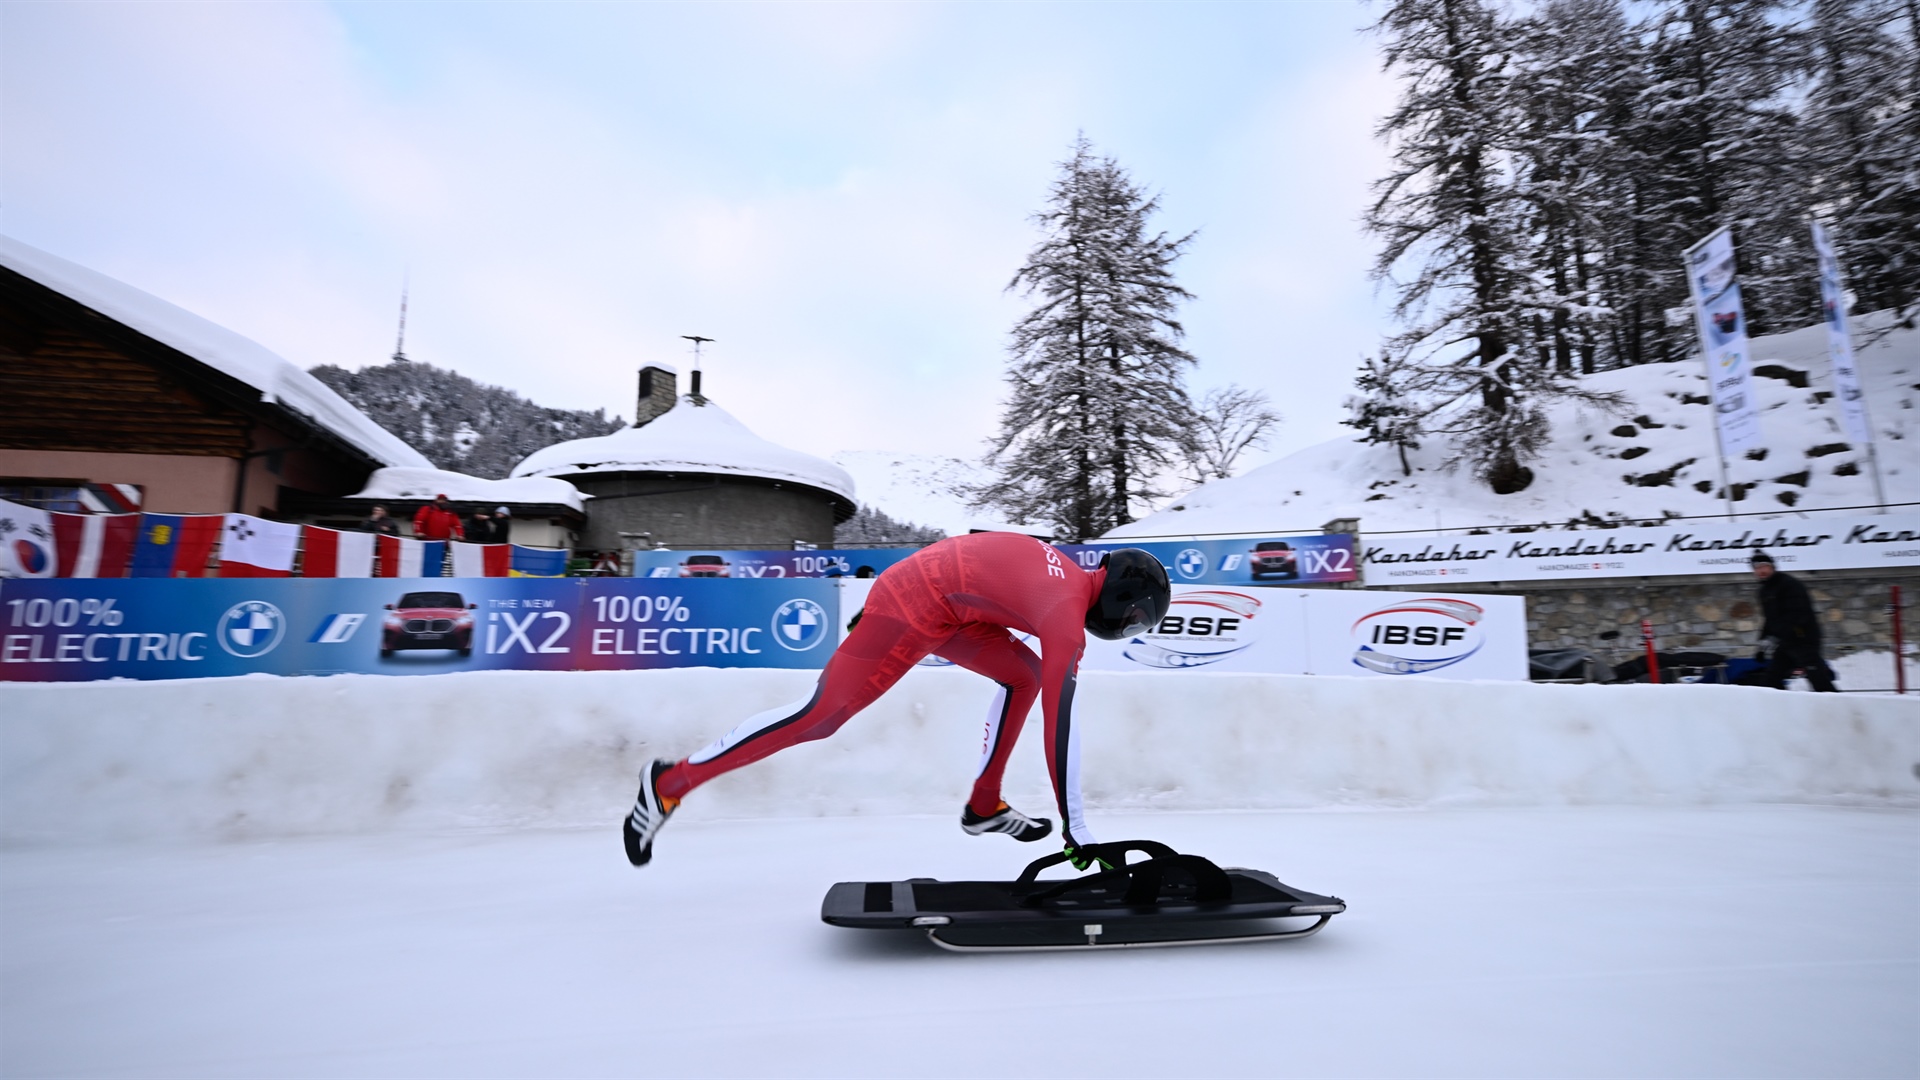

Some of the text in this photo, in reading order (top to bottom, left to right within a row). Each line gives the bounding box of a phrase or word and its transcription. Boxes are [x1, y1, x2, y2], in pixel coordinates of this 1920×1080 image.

[1362, 524, 1920, 564] Kandahar Kandahar Kandahar Kan
[1303, 548, 1353, 574] iX2
[6, 598, 124, 628] 100%
[488, 599, 556, 609] THE NEW
[592, 595, 690, 623] 100%
[485, 611, 571, 654] iX2
[1147, 616, 1241, 637] BSF
[1371, 625, 1467, 646] IBSF
[1, 632, 208, 663] ELECTRIC
[591, 627, 762, 655] ELECTRIC
